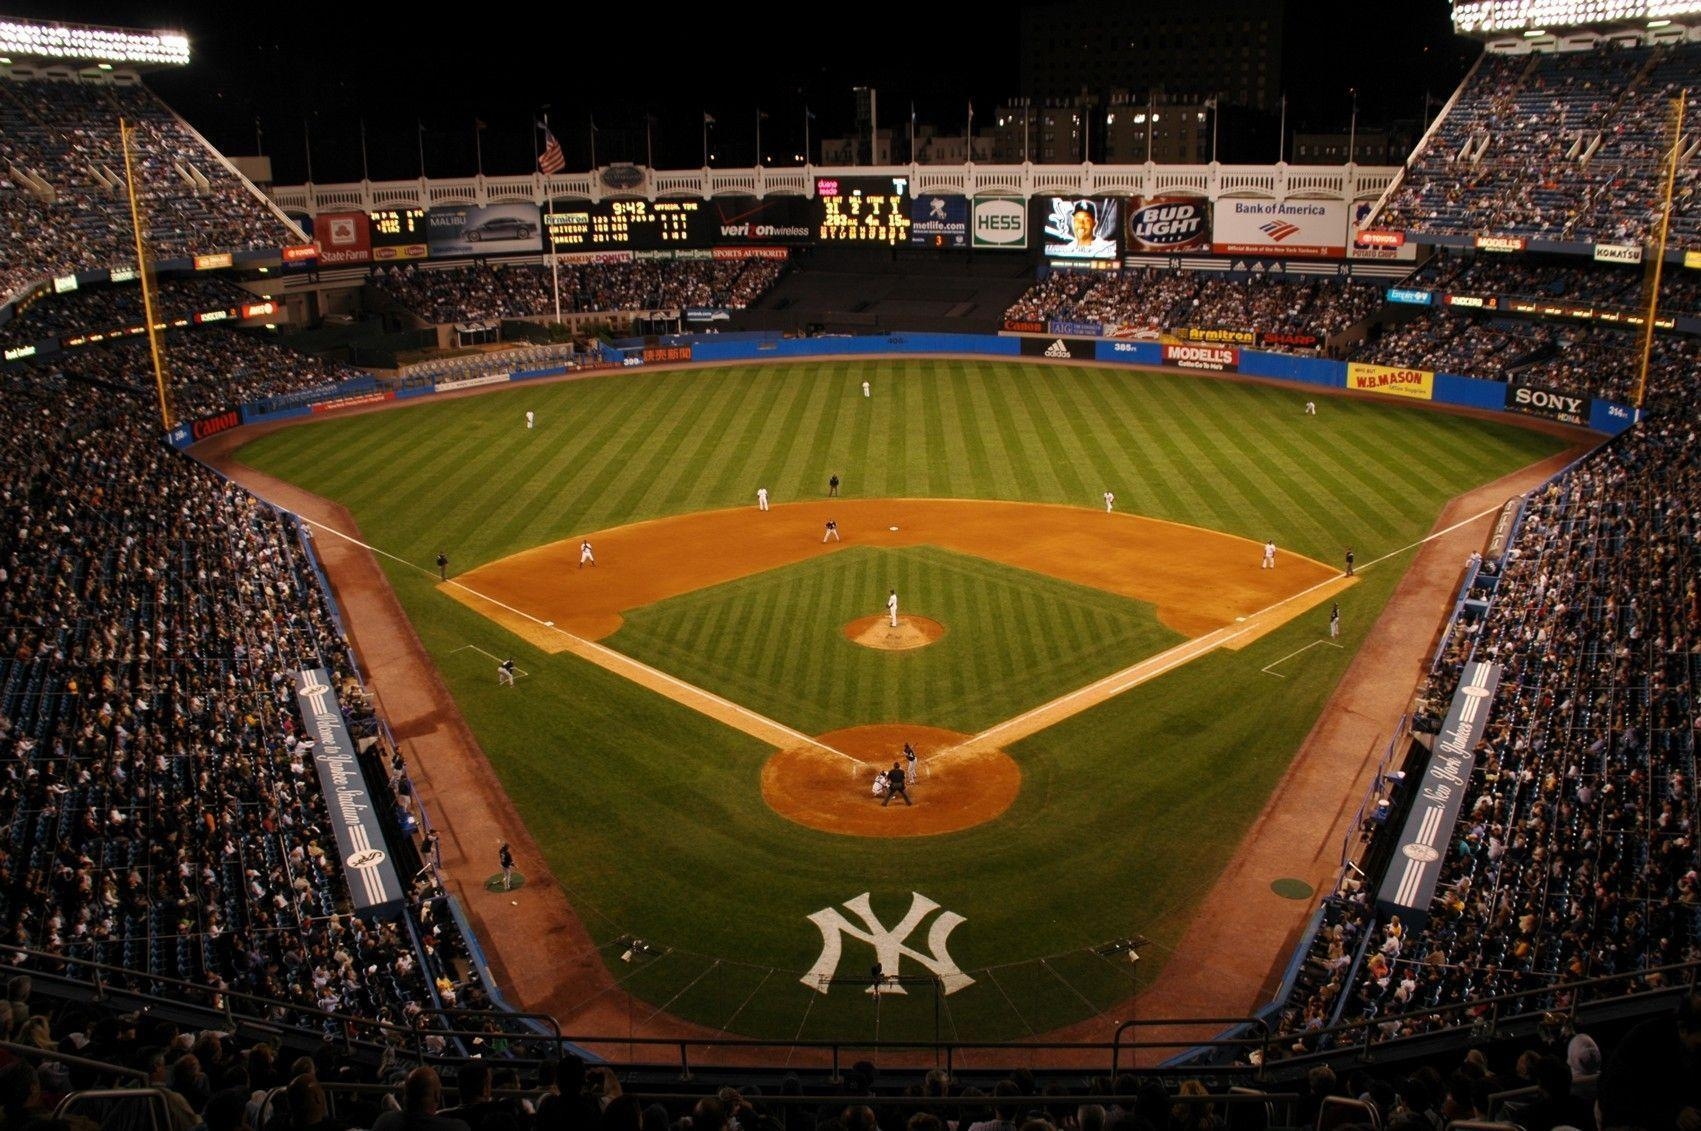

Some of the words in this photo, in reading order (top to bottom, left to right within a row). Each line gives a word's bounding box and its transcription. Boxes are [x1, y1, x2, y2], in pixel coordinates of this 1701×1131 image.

[612, 201, 646, 215] 9:42
[851, 203, 859, 214] 2
[873, 203, 879, 214] 1
[892, 203, 898, 214] 1
[1143, 205, 1195, 223] BUD
[1235, 203, 1263, 213] Bank
[1265, 203, 1277, 214] of
[1278, 204, 1325, 216] America
[430, 217, 466, 227] MALIBU
[913, 220, 965, 230] metlife.com
[978, 215, 1021, 230] HESS
[1136, 217, 1201, 236] LIGHT
[935, 235, 942, 246] 3
[1372, 234, 1397, 243] TOYOTA
[1477, 237, 1521, 249] MODELL'S
[321, 250, 345, 262] State
[345, 249, 368, 260] Farm
[557, 254, 594, 263] DUNKIN'
[595, 253, 631, 261] DONUTS
[713, 249, 742, 257] SPORTS
[743, 249, 788, 257] AUTHORITY
[1352, 249, 1377, 257] POTATO
[1377, 250, 1398, 258] CHIPS
[1597, 249, 1641, 260] KOMATSU
[1450, 296, 1482, 307] KYOCERA
[1004, 321, 1042, 332] Canon
[1054, 323, 1072, 334] AIG
[1189, 328, 1252, 342] Armitron
[1264, 333, 1316, 345] SHARP
[1044, 350, 1071, 358] adidas
[1168, 347, 1232, 364] MODELL'S
[1516, 388, 1582, 413] SONY
[193, 410, 238, 439] Canon
[1440, 722, 1474, 759] Yankees
[316, 754, 357, 786] Yankee
[1430, 754, 1464, 786] York
[1422, 785, 1452, 810] New
[335, 785, 368, 826] Stadium
